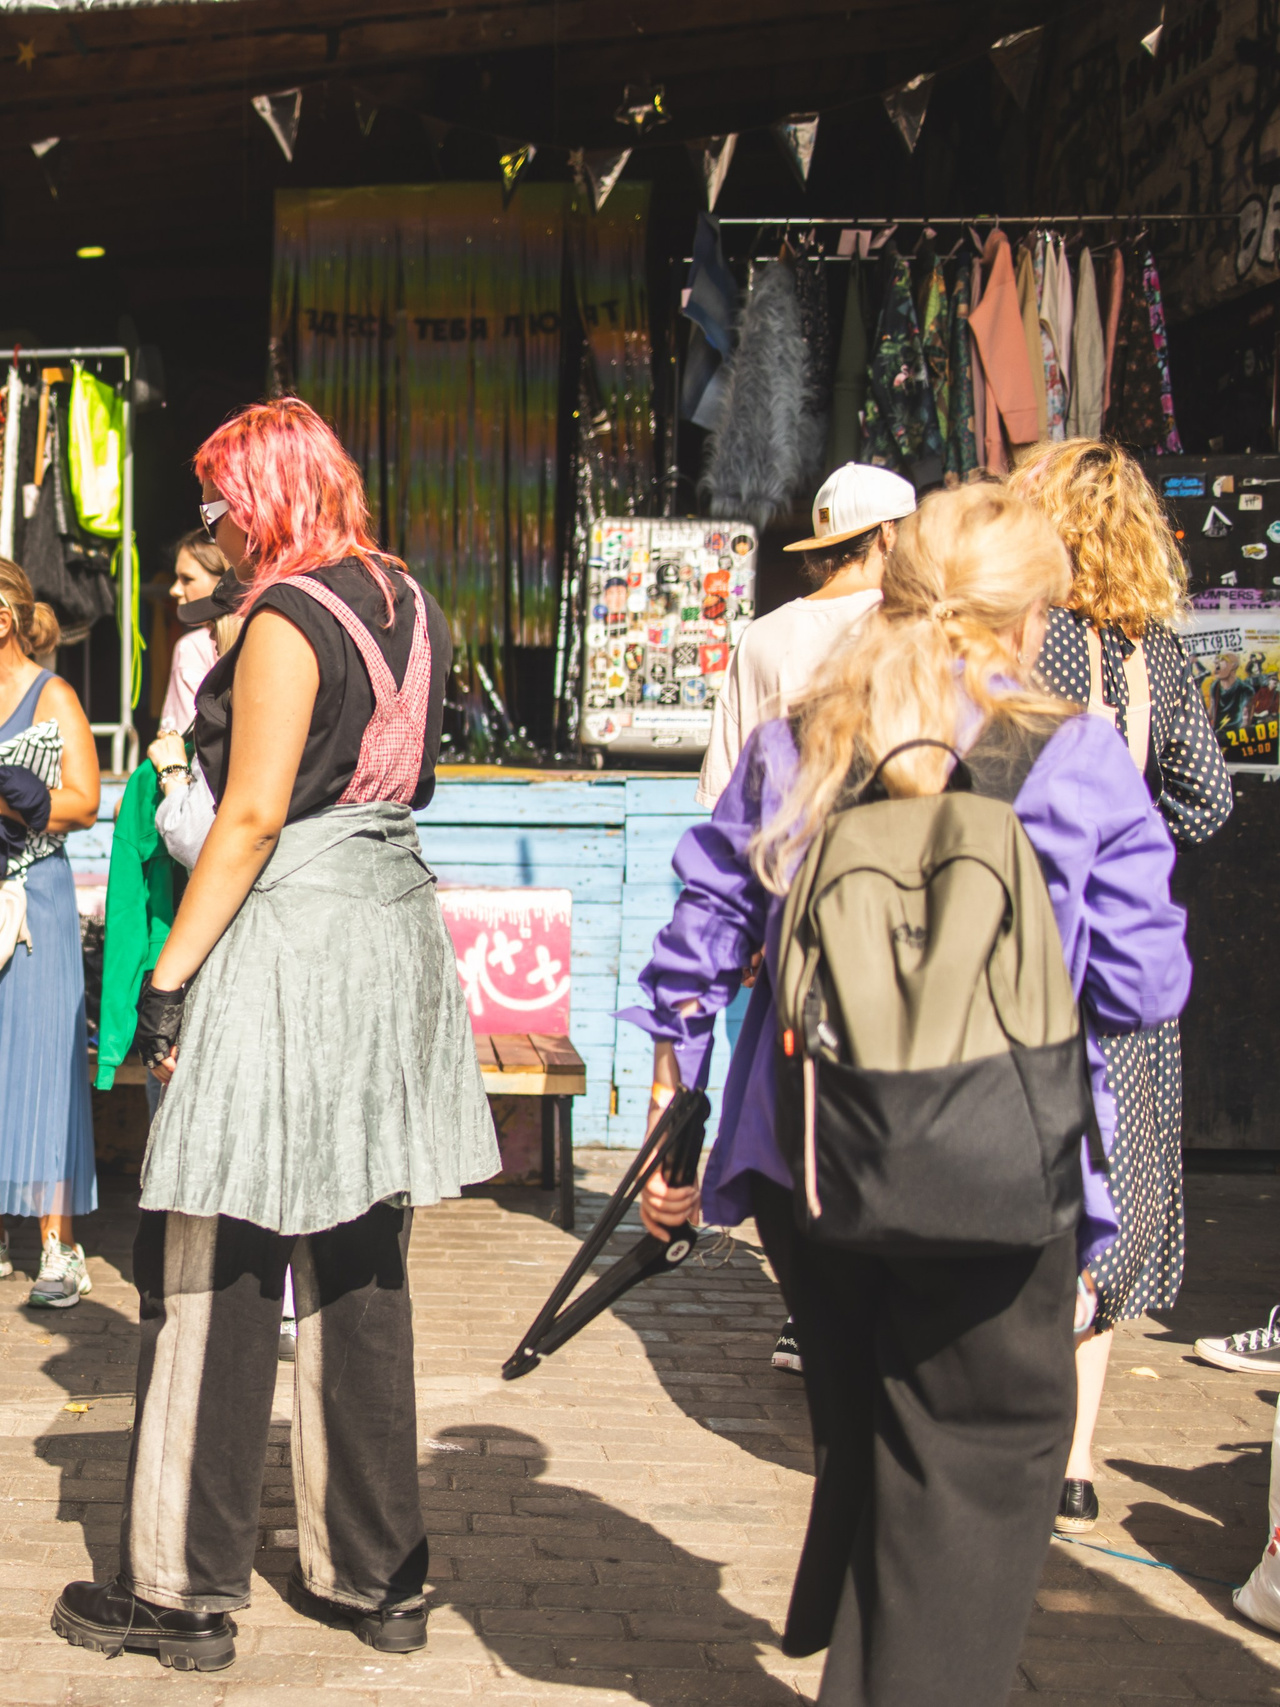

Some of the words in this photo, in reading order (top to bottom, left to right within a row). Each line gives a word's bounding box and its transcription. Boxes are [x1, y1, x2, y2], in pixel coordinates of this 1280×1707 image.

[414, 317, 488, 341] ТЕБЯ
[502, 300, 620, 338] ЛЮЯТ
[1226, 720, 1278, 746] 24.08
